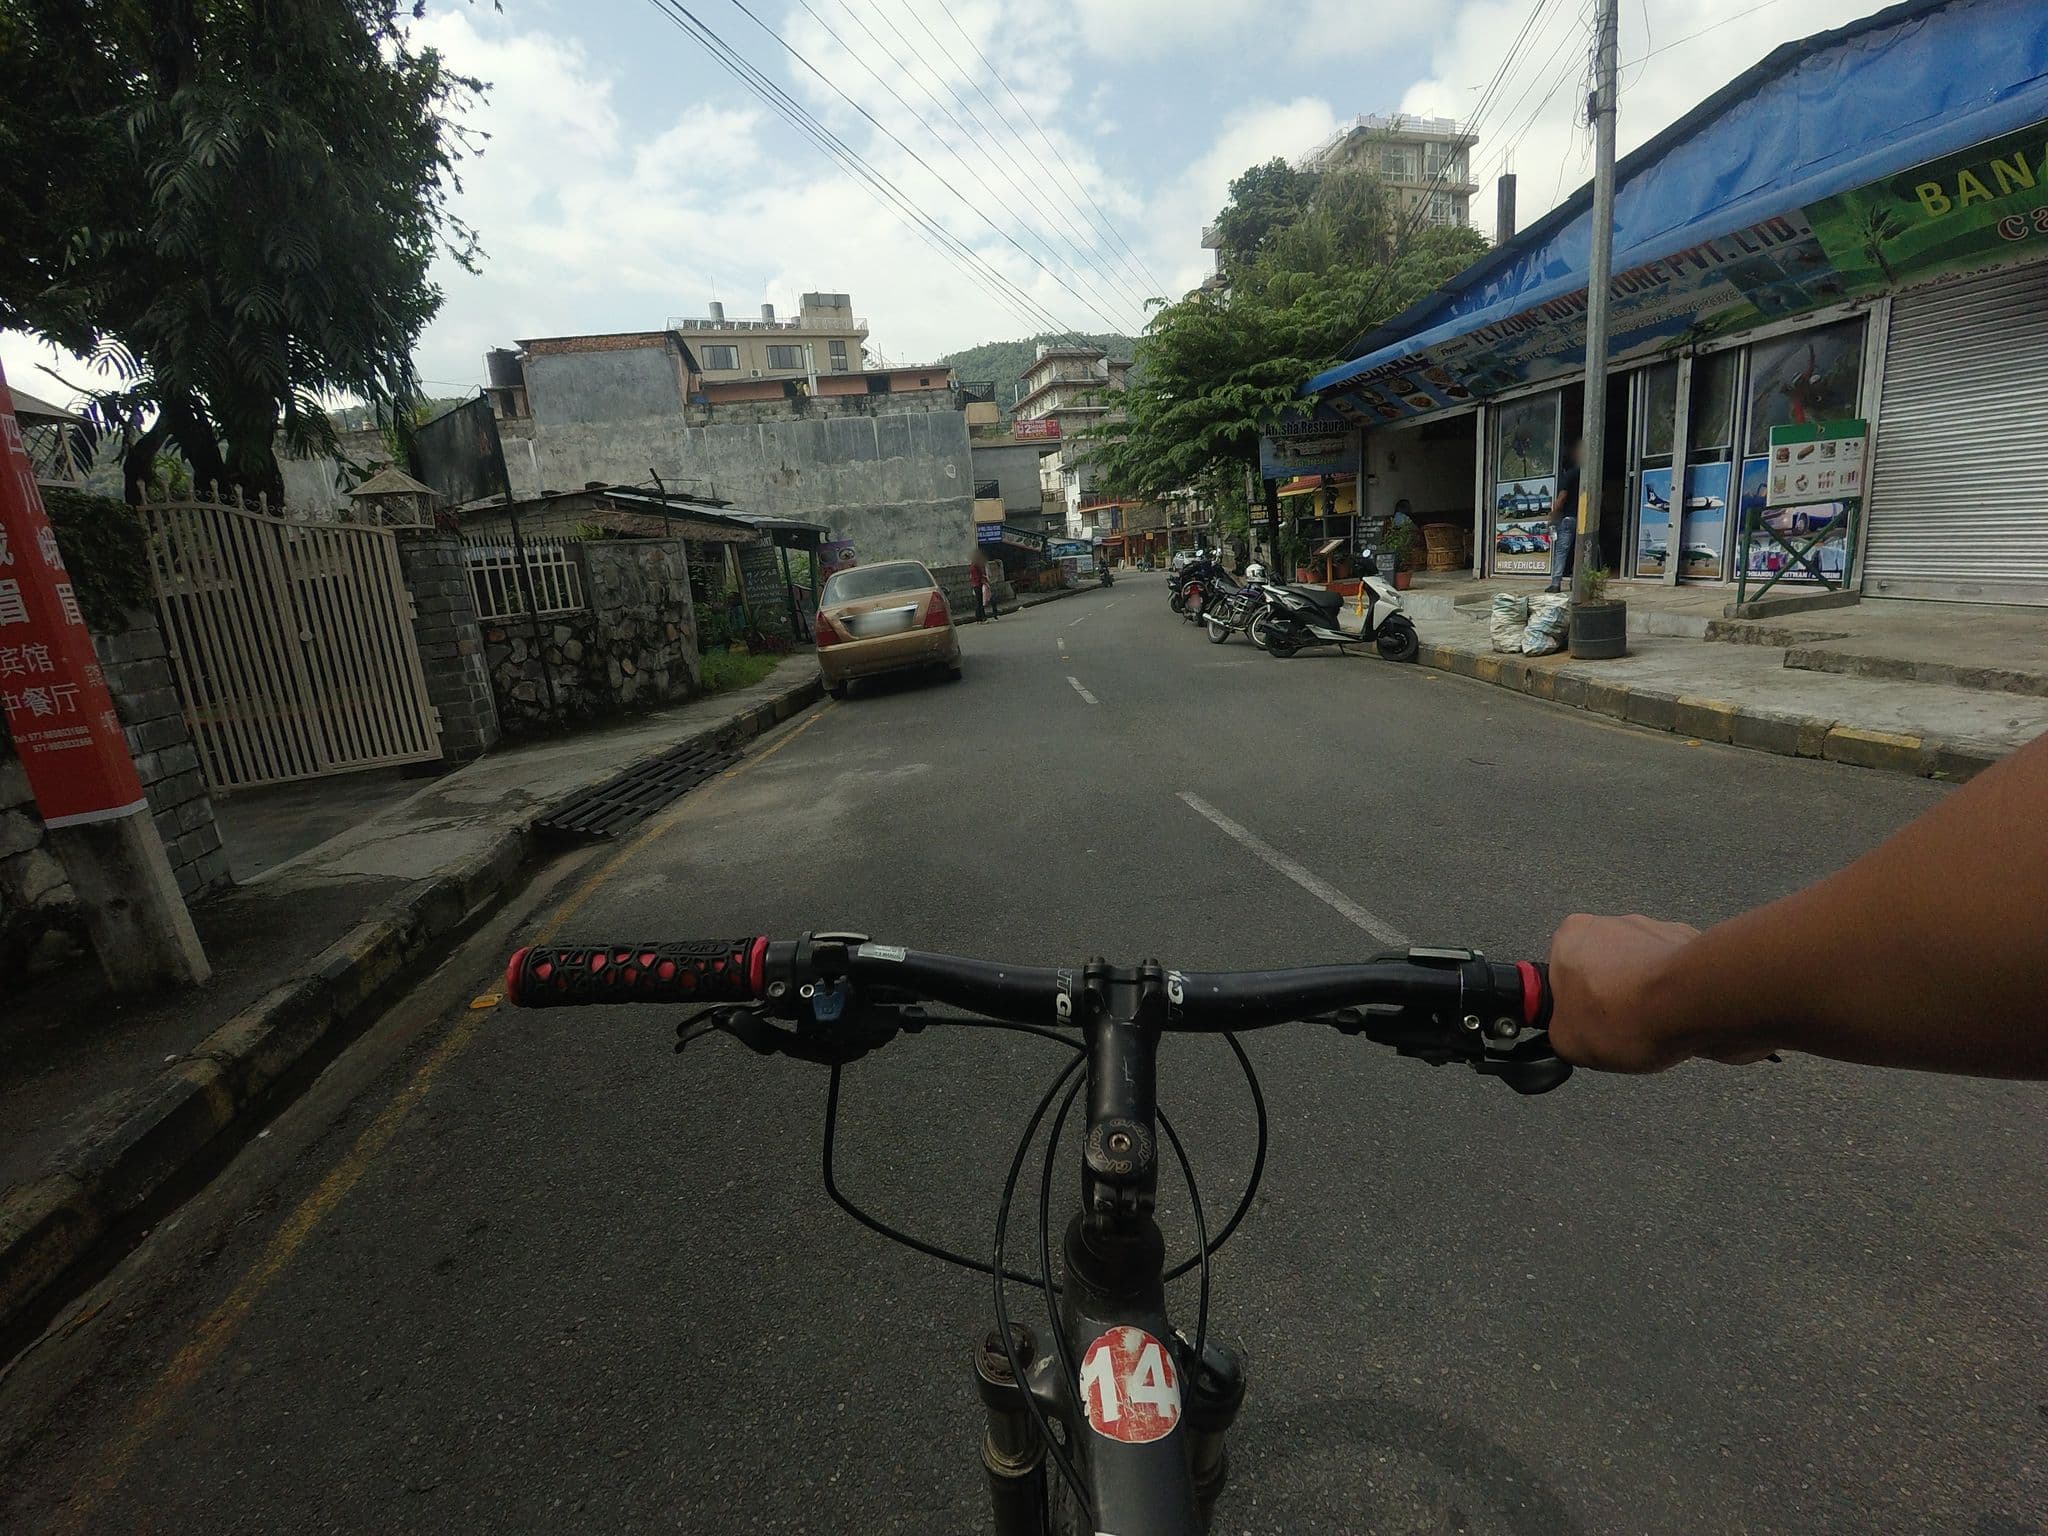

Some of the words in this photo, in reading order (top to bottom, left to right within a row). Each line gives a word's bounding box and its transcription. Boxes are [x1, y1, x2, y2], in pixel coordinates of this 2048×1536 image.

[1915, 143, 2048, 217] BAN
[1265, 421, 1299, 437] Ansha
[1497, 561, 1512, 569] HIRE
[1513, 561, 1546, 570] VEHICLES
[2, 682, 80, 721] 中餐厅
[1081, 1343, 1178, 1422] 14
